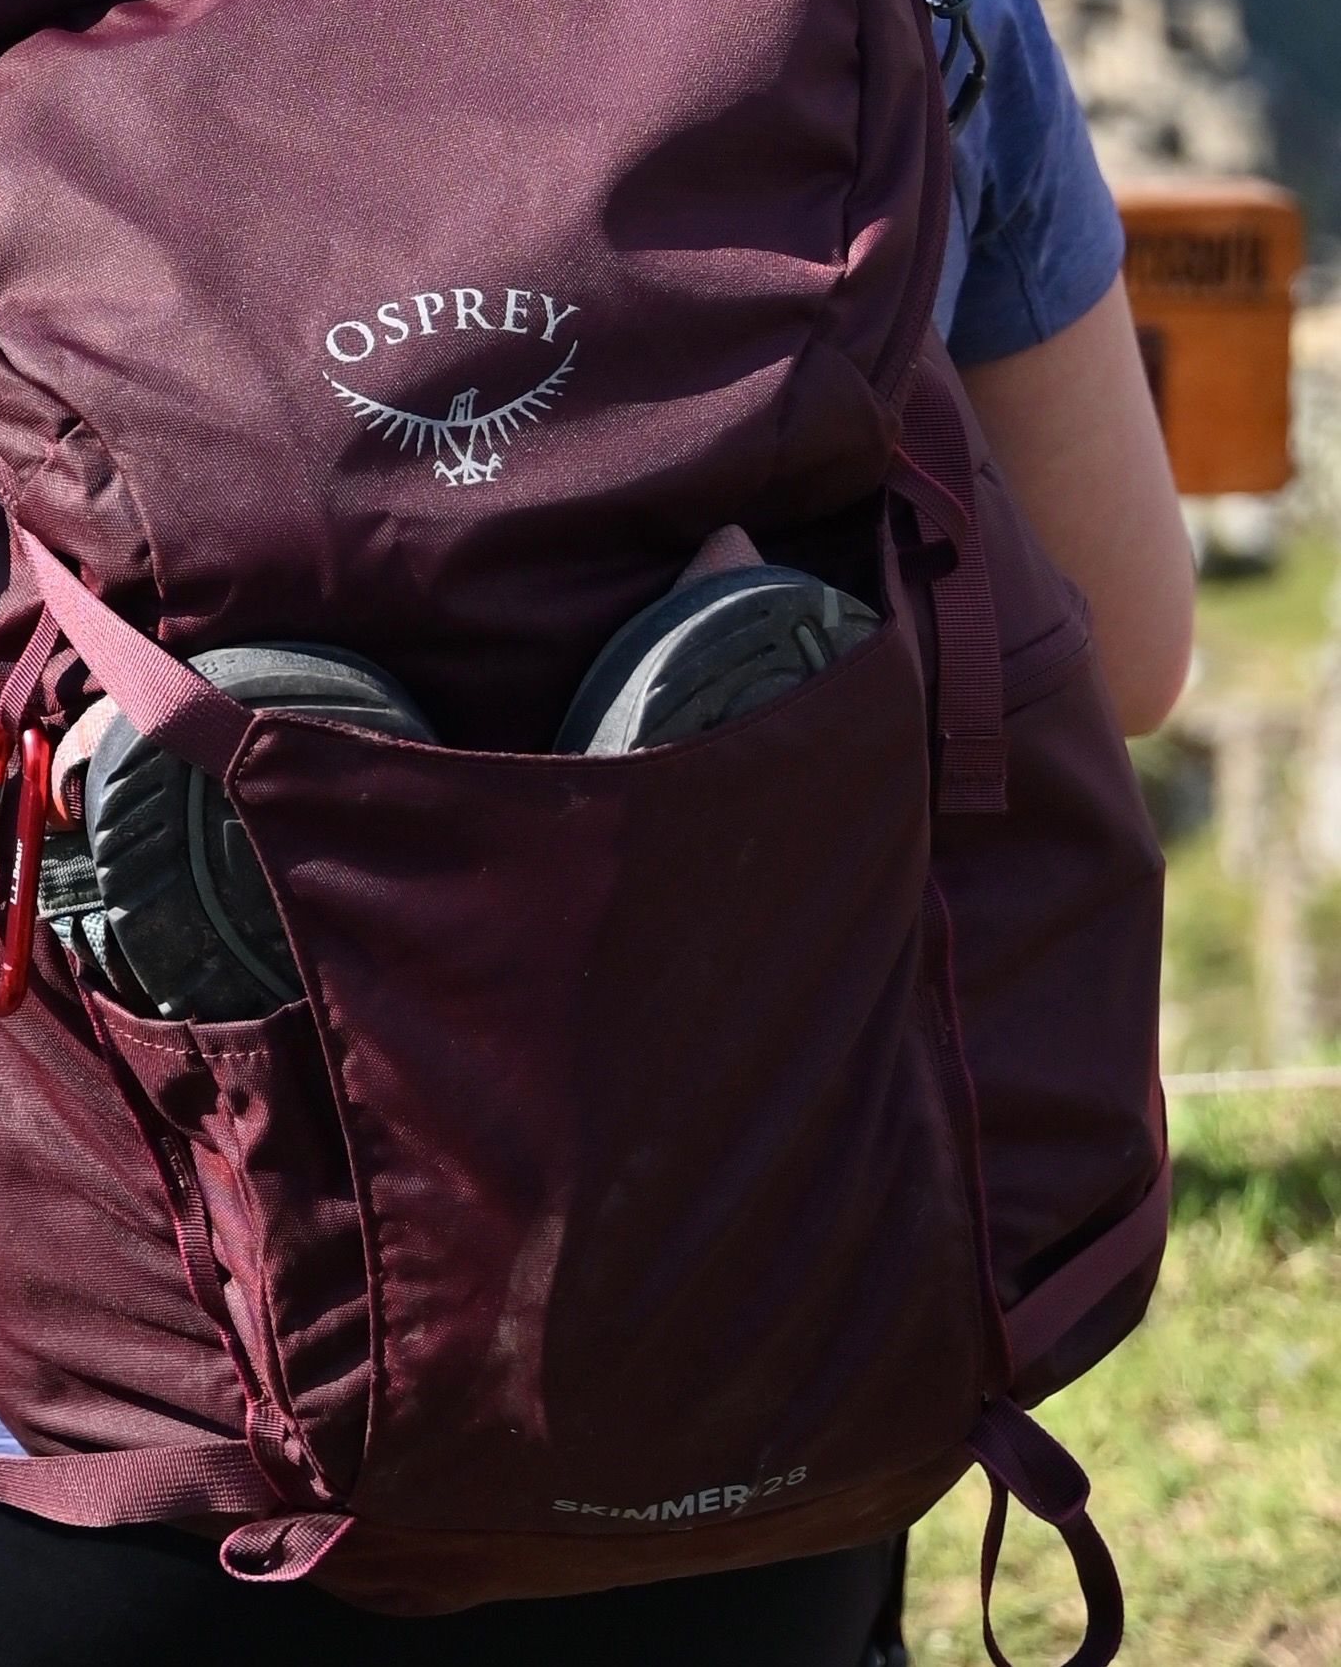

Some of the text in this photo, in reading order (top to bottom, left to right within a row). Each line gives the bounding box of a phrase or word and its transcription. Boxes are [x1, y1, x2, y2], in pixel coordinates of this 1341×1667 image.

[325, 287, 580, 363] OSPREY
[552, 1466, 808, 1522] SKIMMER 28
